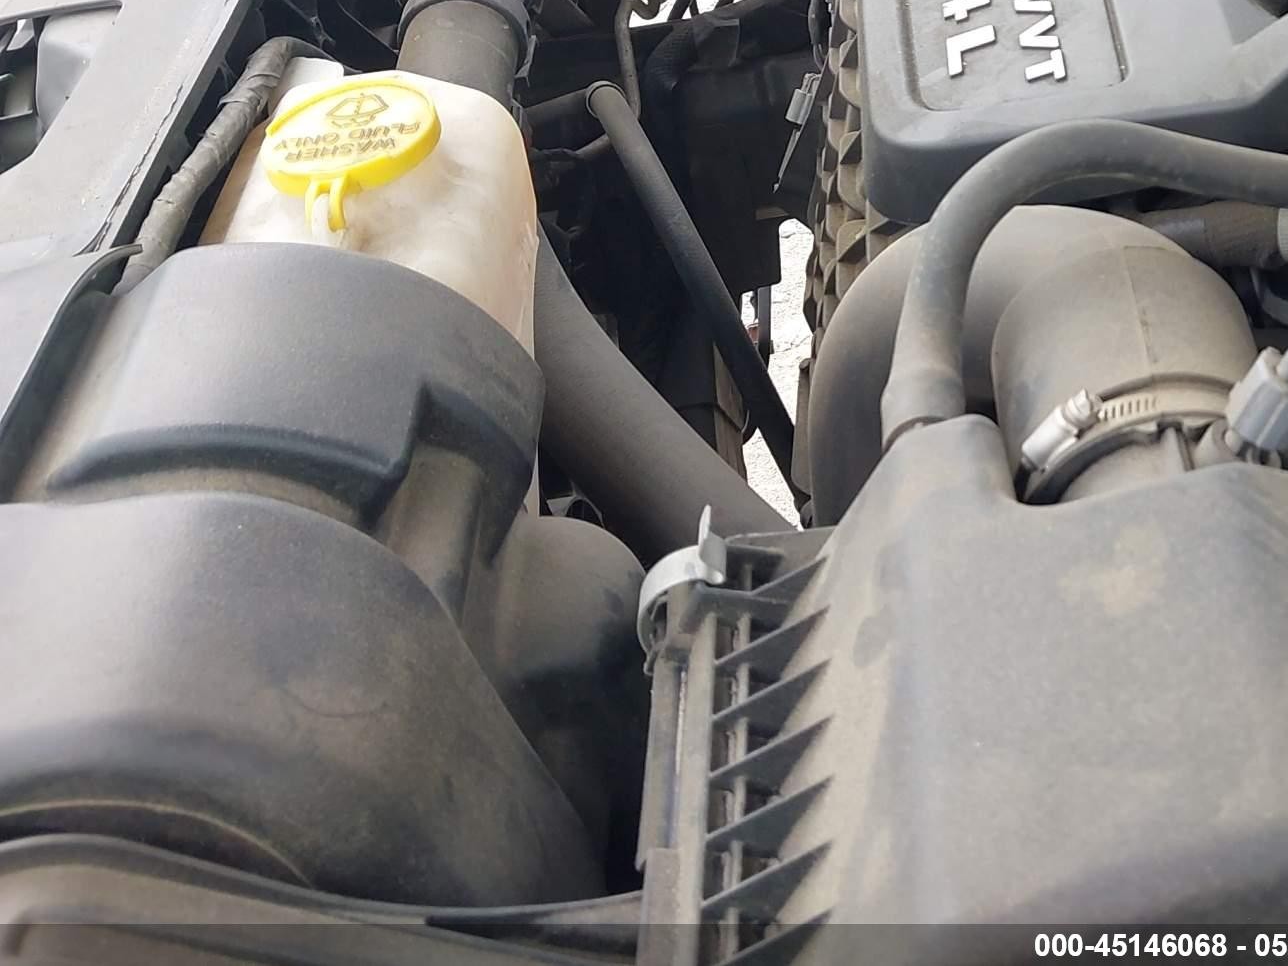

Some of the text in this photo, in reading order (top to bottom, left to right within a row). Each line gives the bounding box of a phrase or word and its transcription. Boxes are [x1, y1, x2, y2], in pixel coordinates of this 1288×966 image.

[274, 121, 421, 152] FLUID ONLY
[285, 138, 397, 163] WASHER
